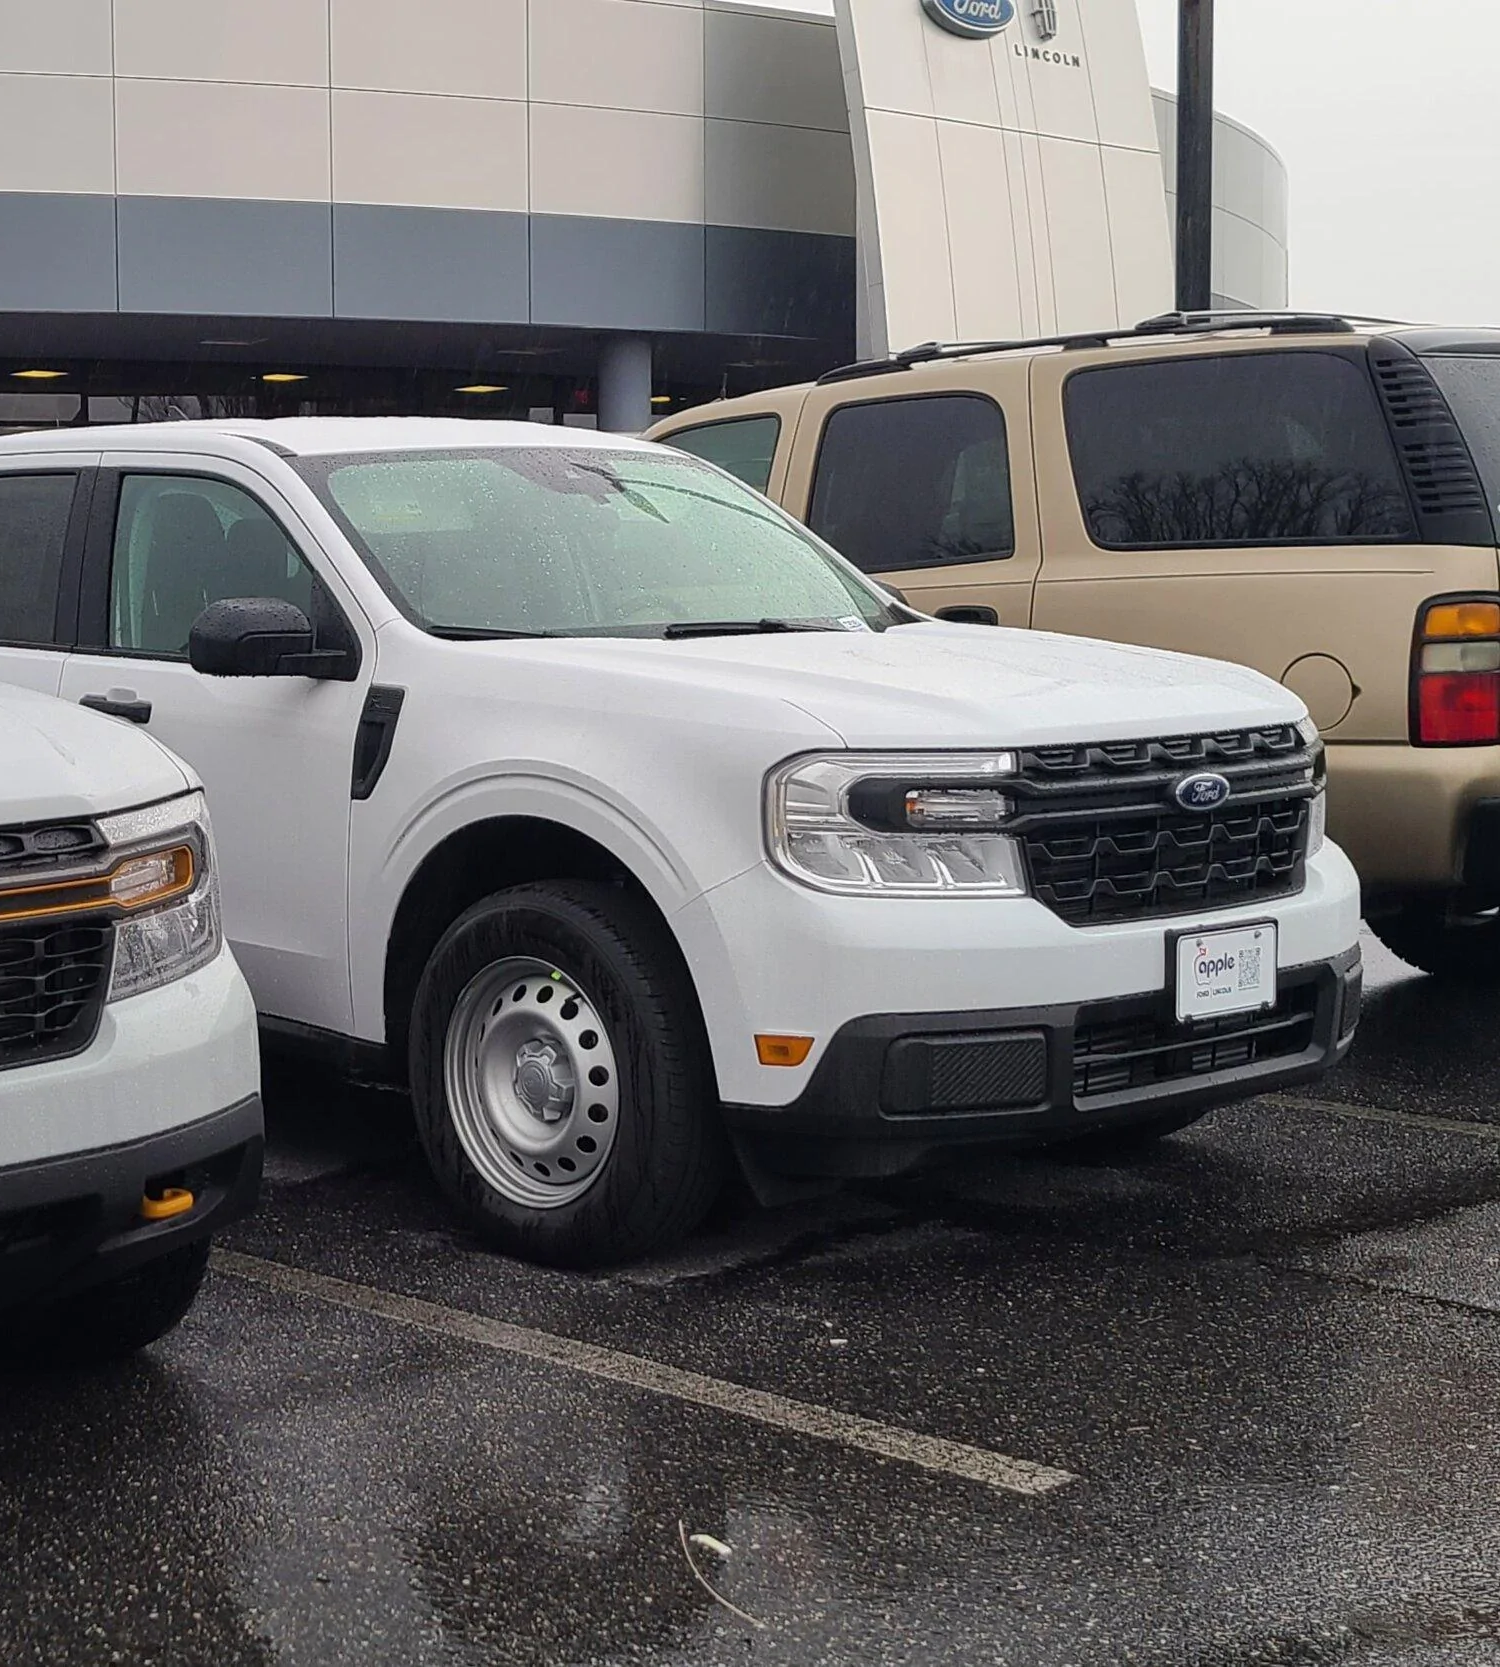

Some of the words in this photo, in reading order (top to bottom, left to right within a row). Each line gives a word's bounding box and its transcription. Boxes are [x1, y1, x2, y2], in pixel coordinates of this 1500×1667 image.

[1013, 43, 1081, 68] LINCOLN
[1191, 780, 1220, 803] Ford
[1198, 952, 1236, 979] apple
